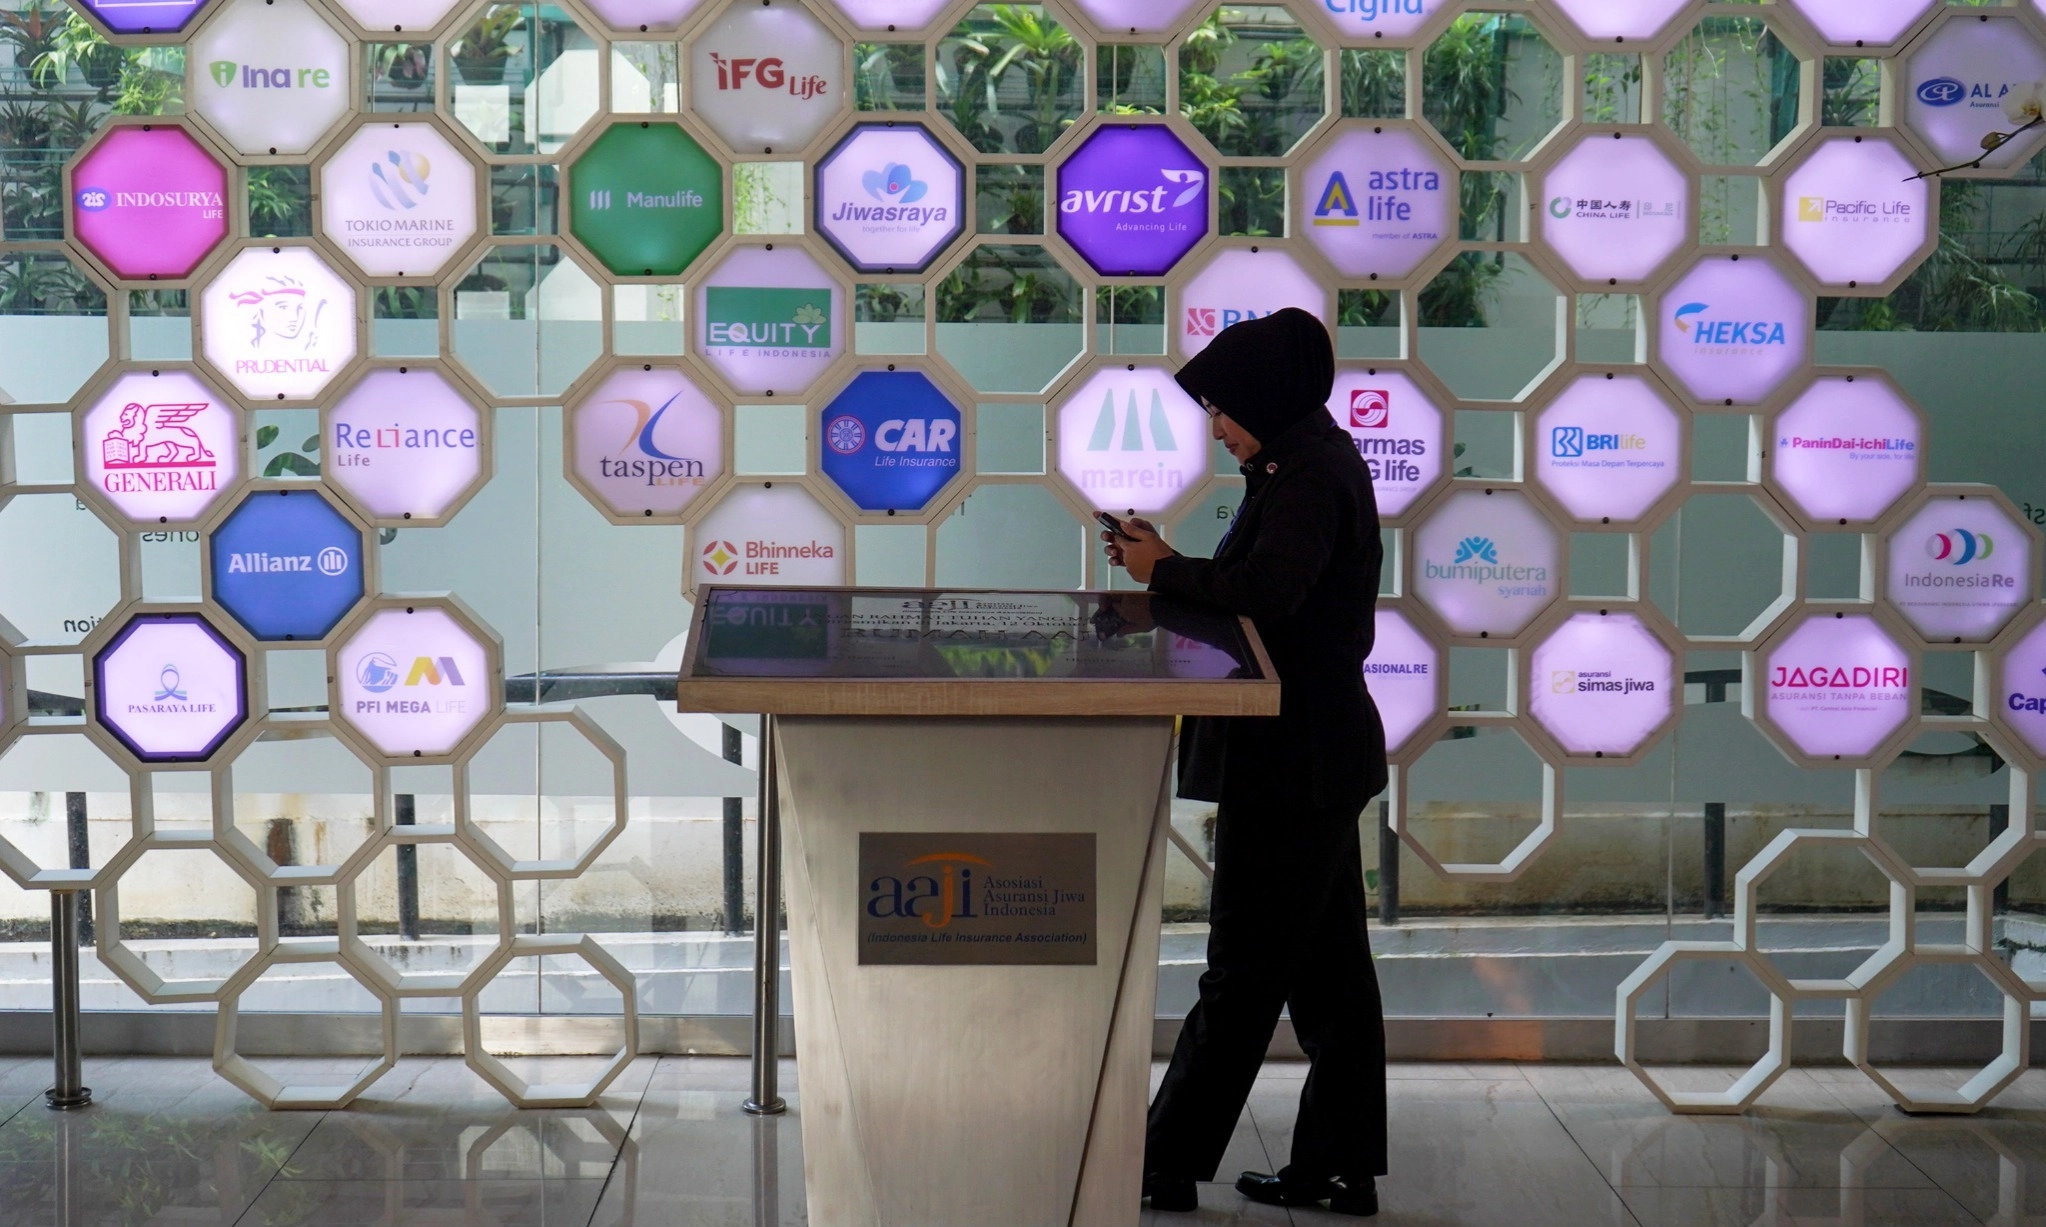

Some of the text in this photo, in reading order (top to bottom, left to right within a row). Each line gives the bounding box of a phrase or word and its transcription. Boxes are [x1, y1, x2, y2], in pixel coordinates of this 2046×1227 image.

[242, 65, 329, 89] Ina re
[709, 52, 827, 100] IFG Life
[1970, 83, 1992, 98] AL
[1369, 168, 1440, 190] astra
[116, 191, 224, 207] INDOSURYA
[627, 191, 703, 208] Manulife
[1060, 185, 1168, 213] avrist
[1576, 199, 1632, 210] 中国人寿
[203, 209, 224, 220] LIFE
[832, 202, 947, 226] Jiwasraya
[1368, 196, 1412, 221] life
[1576, 211, 1630, 219] CHINA LIFE
[1825, 200, 1911, 215] Pacific Life
[345, 220, 454, 231] TOKIO MARINE
[862, 225, 921, 234] together for life
[1115, 222, 1188, 233] Advancing Life
[348, 238, 453, 247] INSURANCE GROUP
[709, 323, 821, 344] EQUITY
[1694, 321, 1785, 345] HEKSA
[705, 348, 831, 358] LIFE INDONESIA
[236, 358, 329, 374] PRUDENTIAL
[874, 418, 956, 452] CAR
[338, 454, 371, 467] Life
[874, 455, 956, 468] Life Insurance
[1601, 460, 1625, 468] Depan
[1626, 460, 1665, 468] Terpercaya
[599, 454, 705, 486] taspen
[1082, 462, 1183, 489] marein
[1385, 459, 1420, 482] life
[104, 471, 217, 493] GENERALI
[656, 478, 706, 486] LIFE
[746, 540, 834, 559] Bhinneka
[228, 552, 313, 573] Allianz
[746, 562, 780, 575] LIFE
[1425, 560, 1546, 584] bumiputera
[1498, 583, 1547, 599] syariah
[1771, 667, 1907, 687] JAGADIRI
[1771, 692, 1906, 701] ASURANSI TANPA BEBAN
[128, 704, 216, 713] PASARAYA LIFE
[356, 700, 466, 713] PFI MEGA LIFE
[983, 876, 1043, 889] Asosiasi
[983, 889, 1085, 905] Asuransi Jiwa
[983, 902, 1056, 917] Indonesia
[867, 931, 1088, 945] (Indonesia Life Insurance Association)
